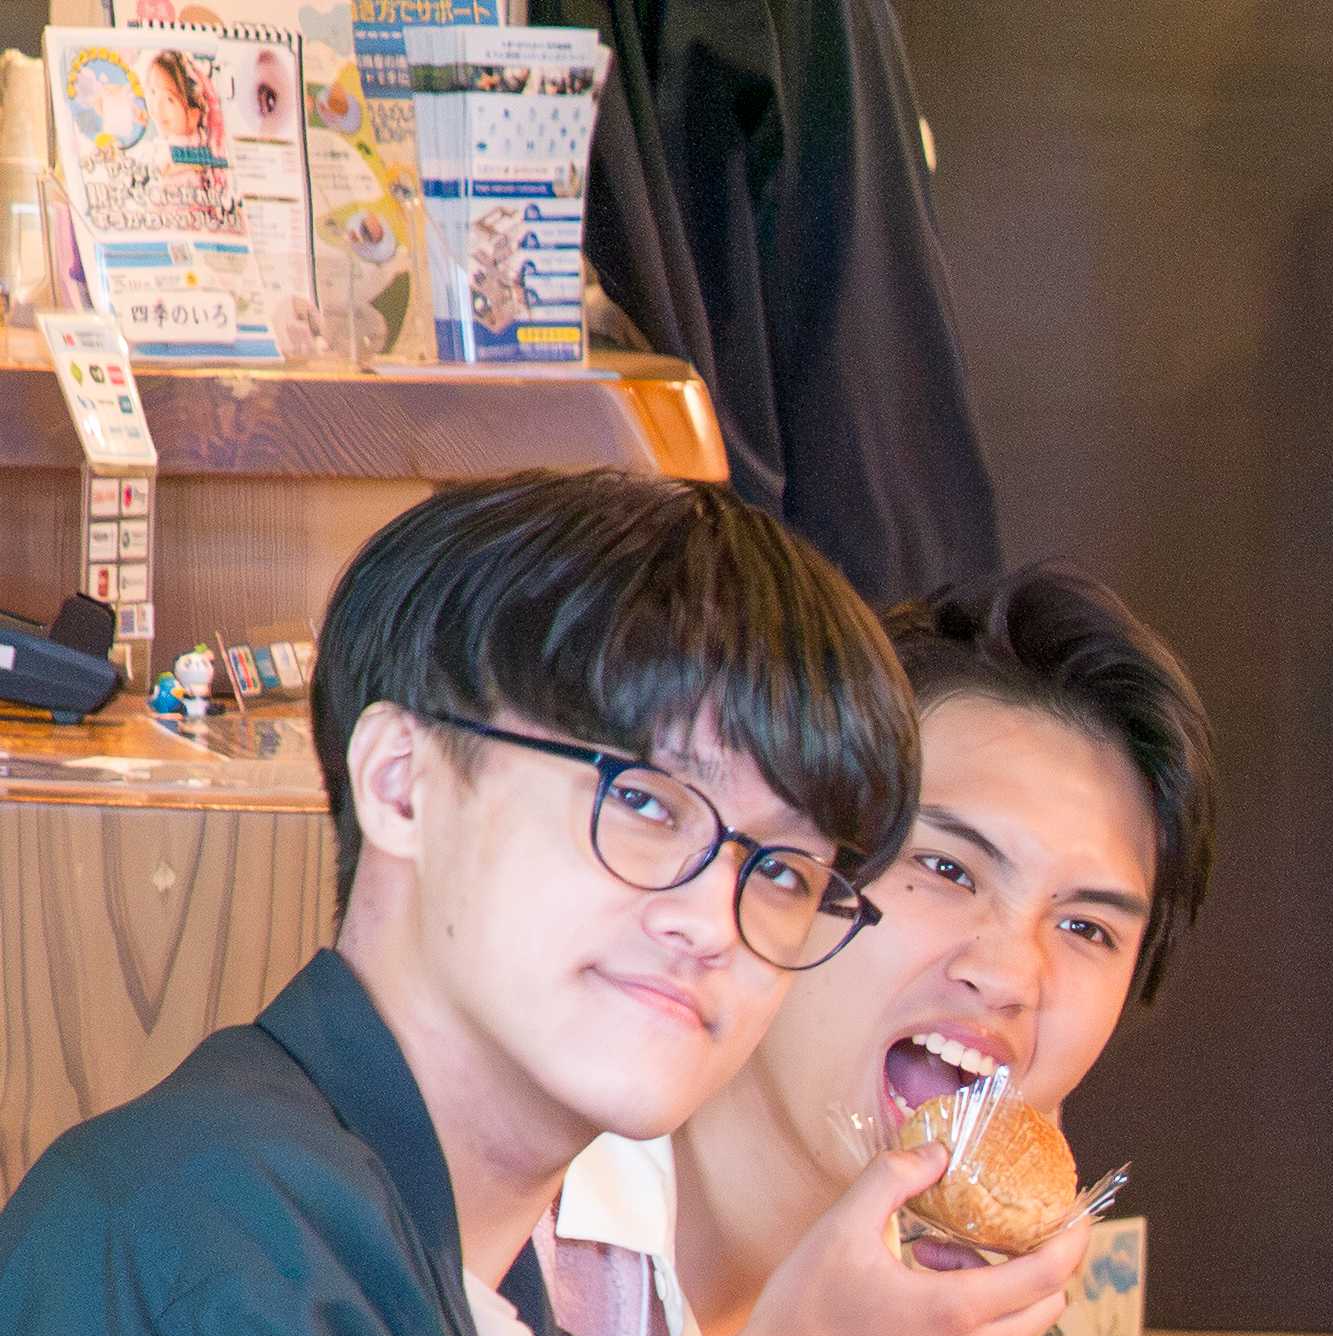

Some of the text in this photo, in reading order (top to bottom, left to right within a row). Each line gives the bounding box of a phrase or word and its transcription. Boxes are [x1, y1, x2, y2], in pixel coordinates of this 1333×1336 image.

[131, 303, 229, 329] 四季のいろ
